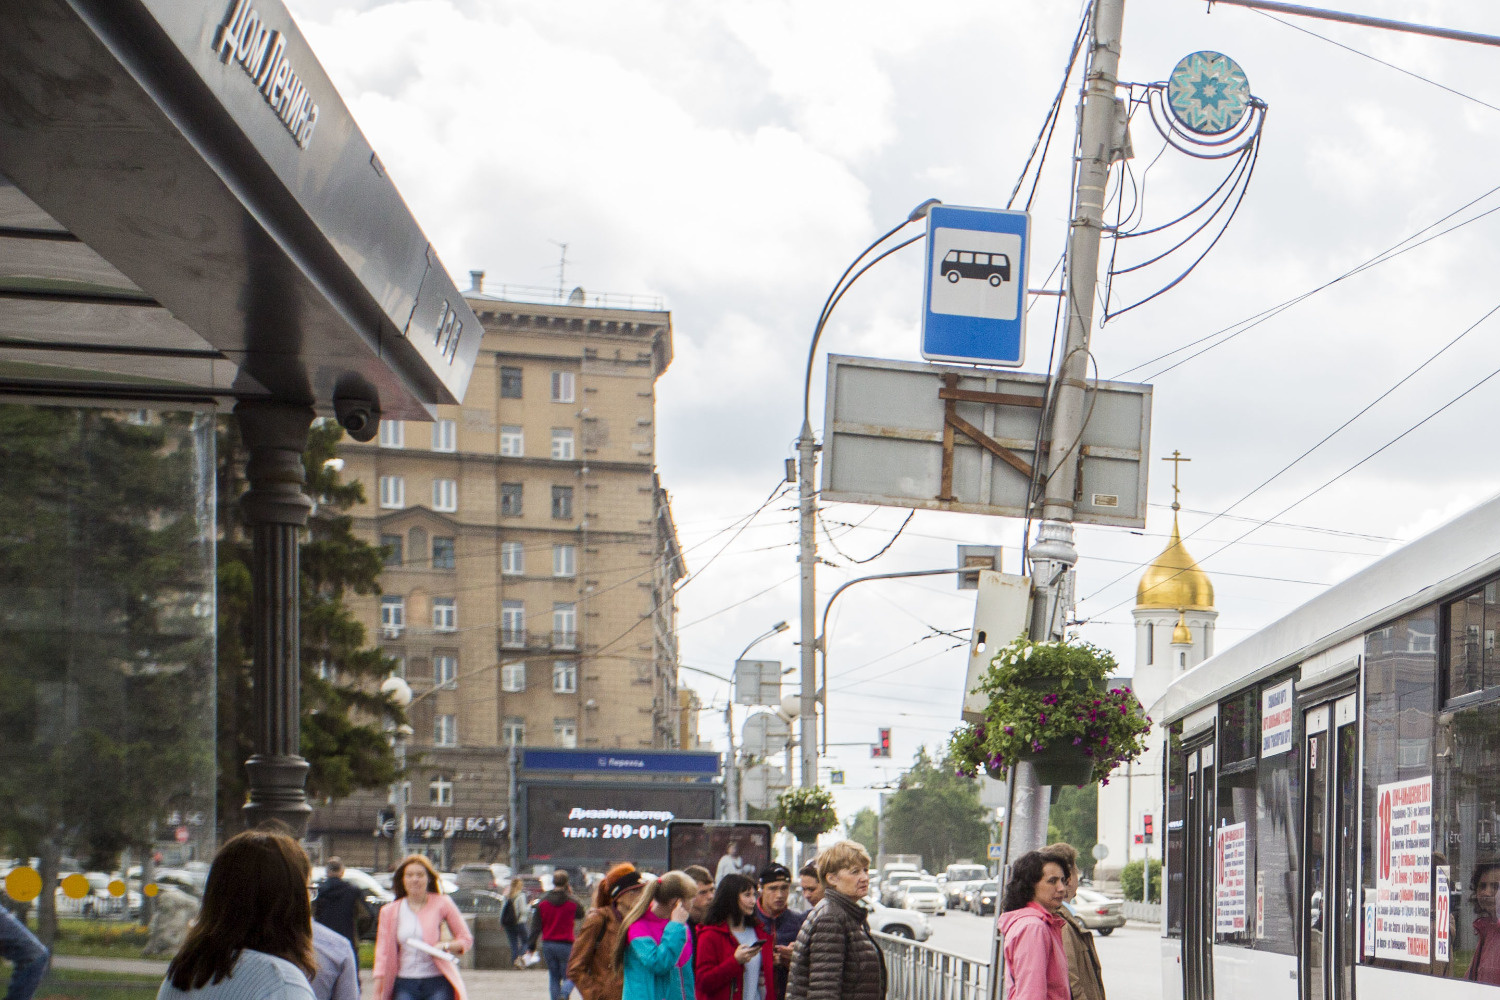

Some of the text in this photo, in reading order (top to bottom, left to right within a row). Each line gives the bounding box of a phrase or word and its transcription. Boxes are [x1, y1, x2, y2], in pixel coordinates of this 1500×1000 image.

[257, 29, 320, 151] Ленина
[413, 815, 443, 831] ИЛЬ
[443, 816, 464, 832] ДЕ
[1437, 894, 1448, 939] 22
